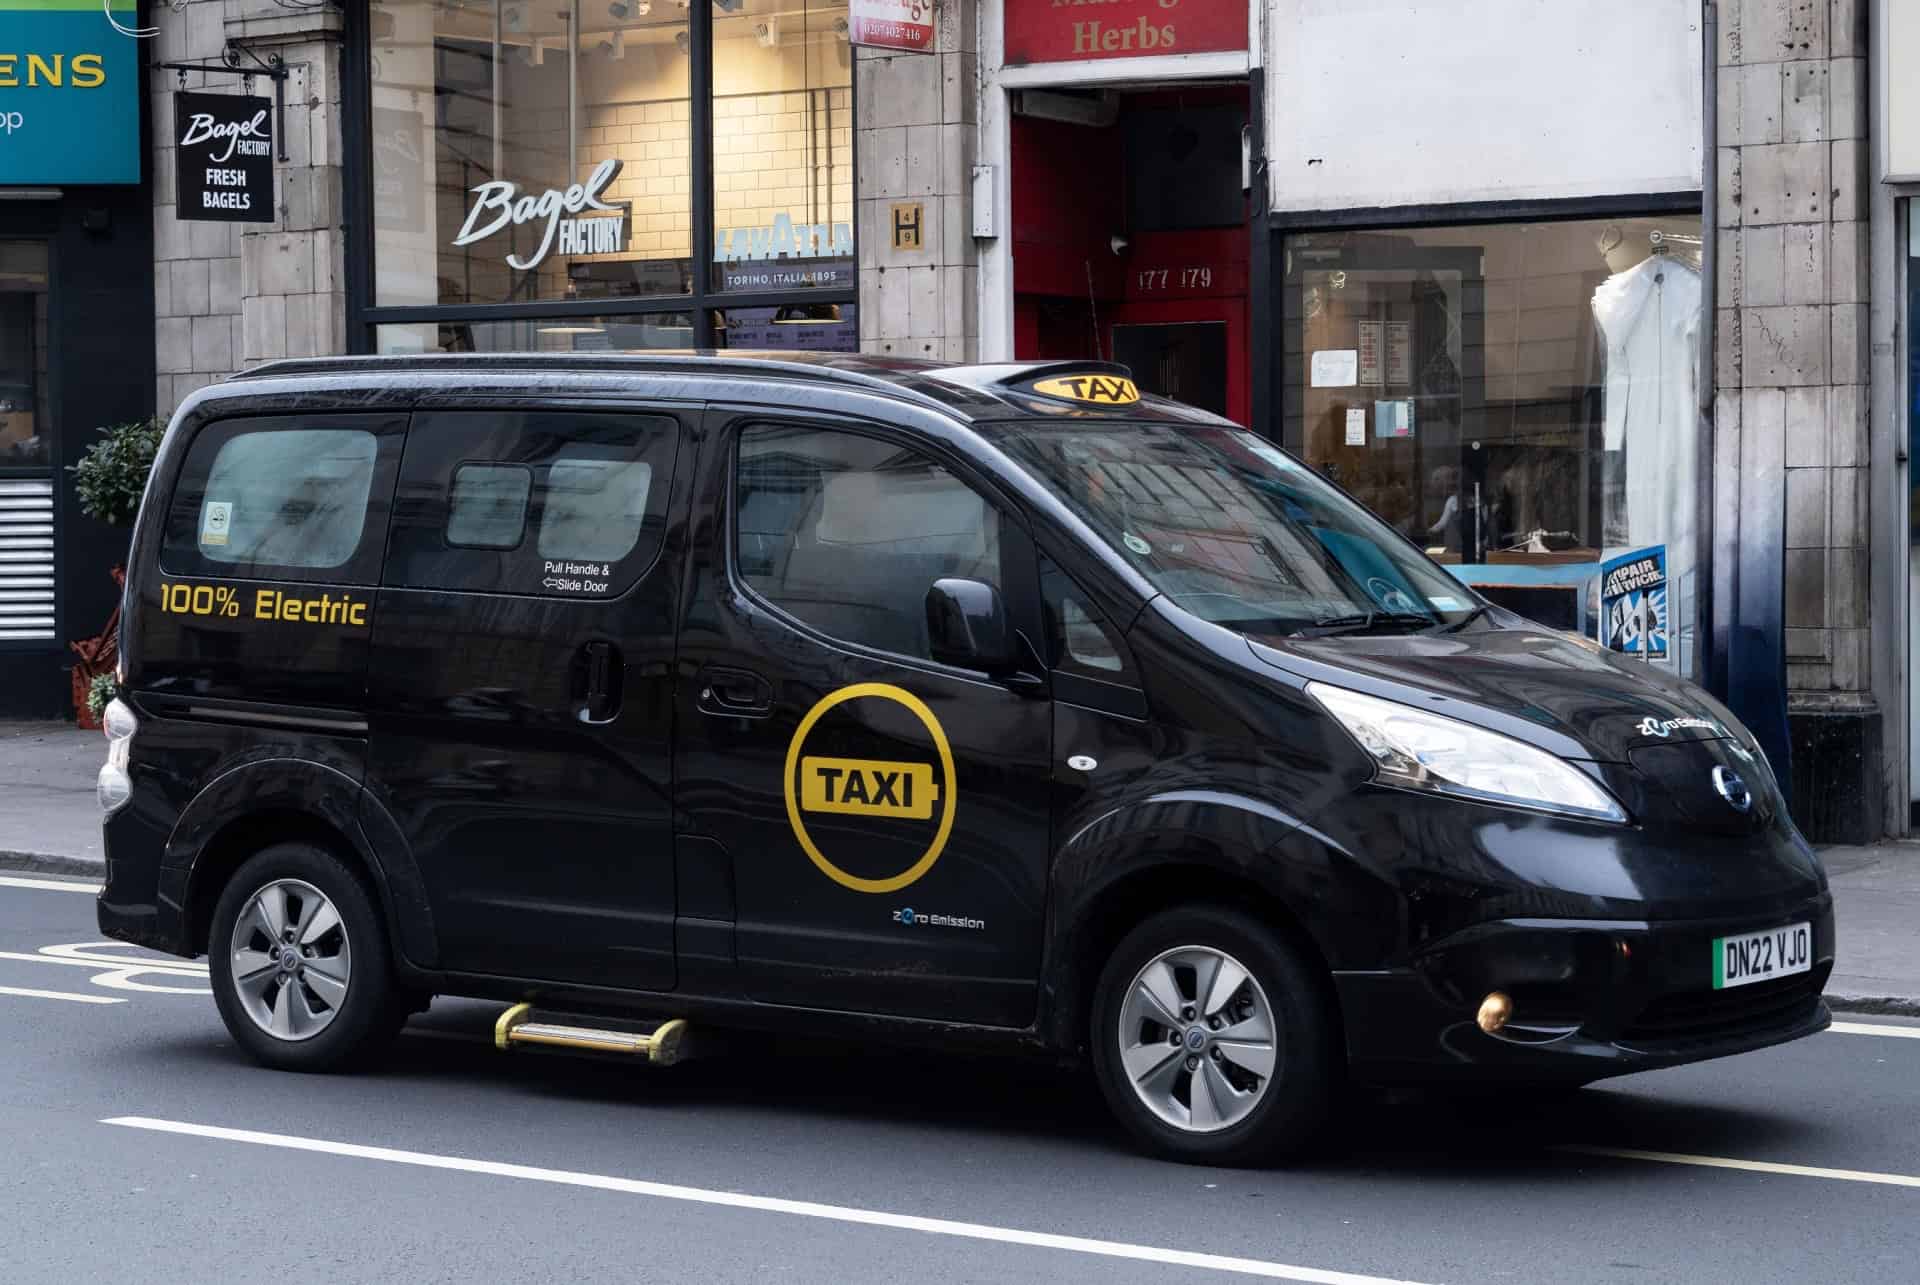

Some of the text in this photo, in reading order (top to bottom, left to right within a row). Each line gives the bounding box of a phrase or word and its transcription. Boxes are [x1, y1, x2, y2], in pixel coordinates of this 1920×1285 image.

[1072, 16, 1177, 53] Herbs
[181, 109, 271, 163] Bagel
[237, 140, 271, 157] FACTORY
[206, 167, 247, 187] FRESH
[202, 191, 251, 210] BAGELS
[452, 158, 625, 271] Bagel
[559, 215, 625, 256] FACTORY
[1058, 377, 1138, 402] TAXI
[544, 561, 609, 576] Pull Handle &
[558, 578, 609, 592] Slide Door
[160, 583, 367, 626] 100% Electric
[816, 767, 913, 808] TAXI
[930, 913, 985, 930] Emission
[1726, 935, 1773, 980] DN22
